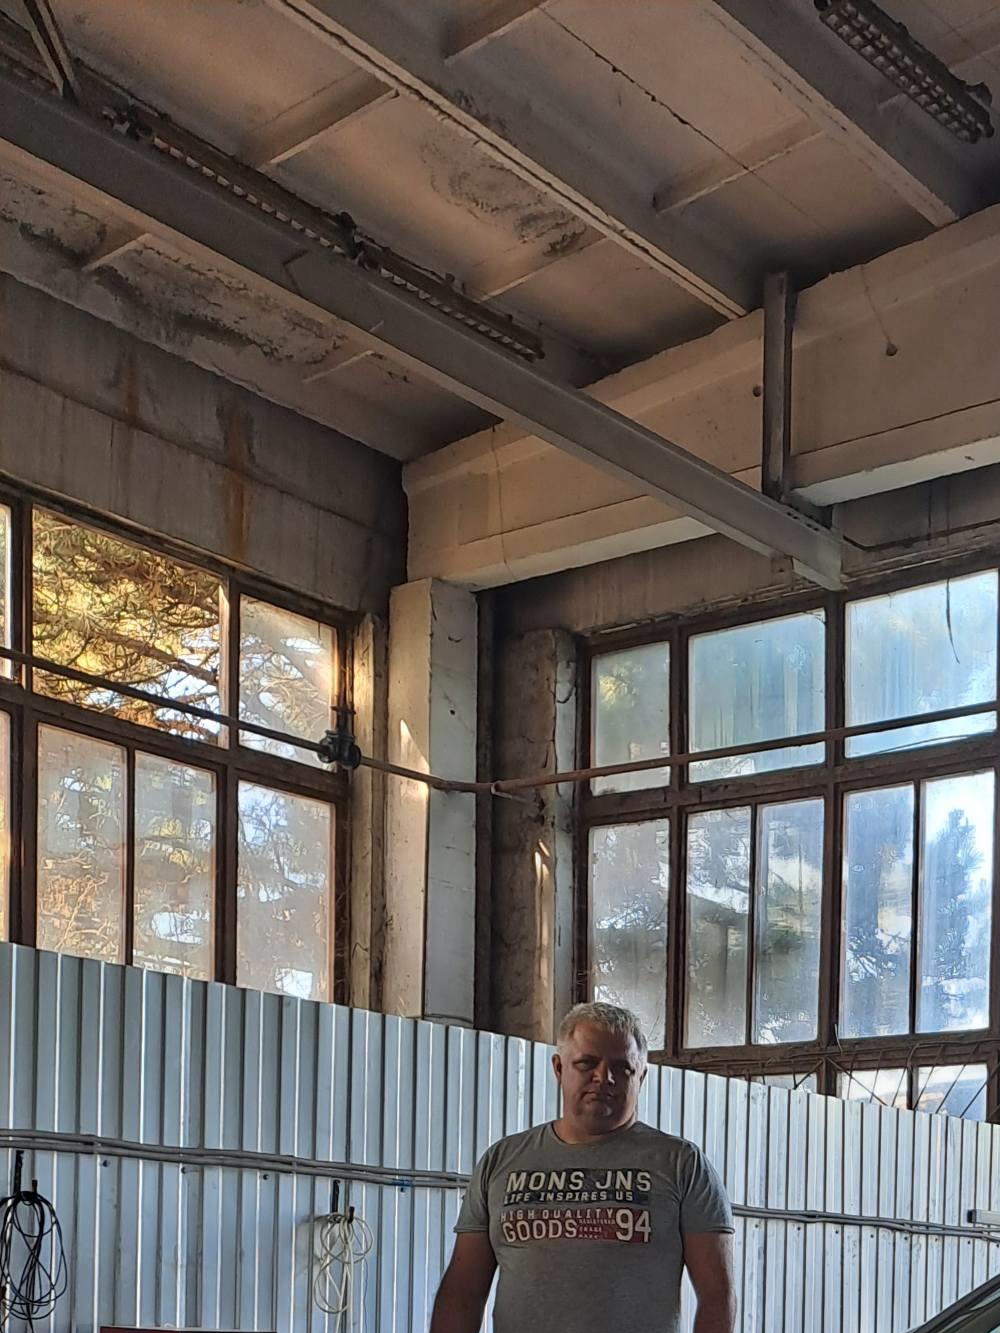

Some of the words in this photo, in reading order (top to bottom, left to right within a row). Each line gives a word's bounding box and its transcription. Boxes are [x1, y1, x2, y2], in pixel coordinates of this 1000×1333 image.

[506, 1171, 585, 1192] MONS
[595, 1170, 651, 1192] JNS
[503, 1192, 532, 1205] LIFE
[540, 1191, 607, 1202] INSPIRES
[615, 1191, 634, 1201] US
[500, 1209, 536, 1223] HIGH
[542, 1208, 614, 1220] QUALITY
[502, 1219, 578, 1242] GOODS
[615, 1208, 652, 1242] 94
